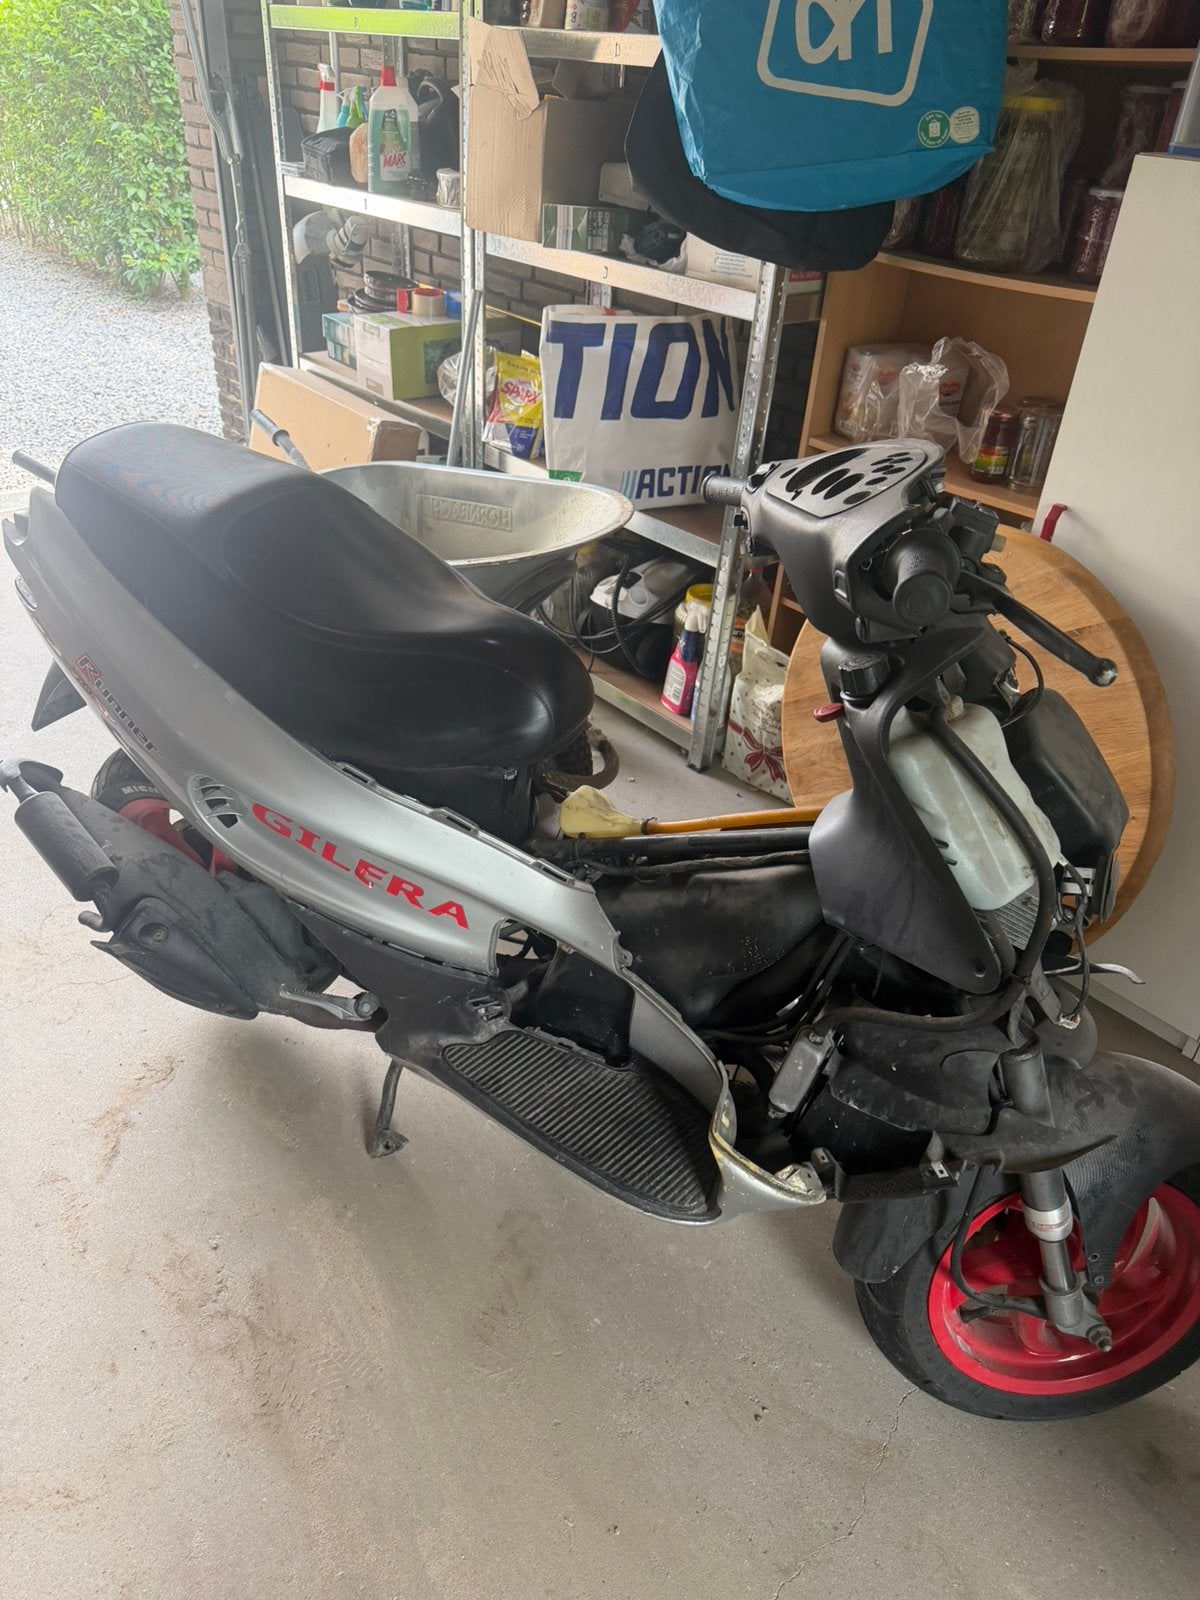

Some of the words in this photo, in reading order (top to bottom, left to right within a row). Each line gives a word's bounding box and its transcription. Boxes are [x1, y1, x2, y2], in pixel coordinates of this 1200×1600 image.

[546, 316, 736, 420] TION
[76, 652, 159, 752] Runner
[251, 802, 470, 930] GILERA
